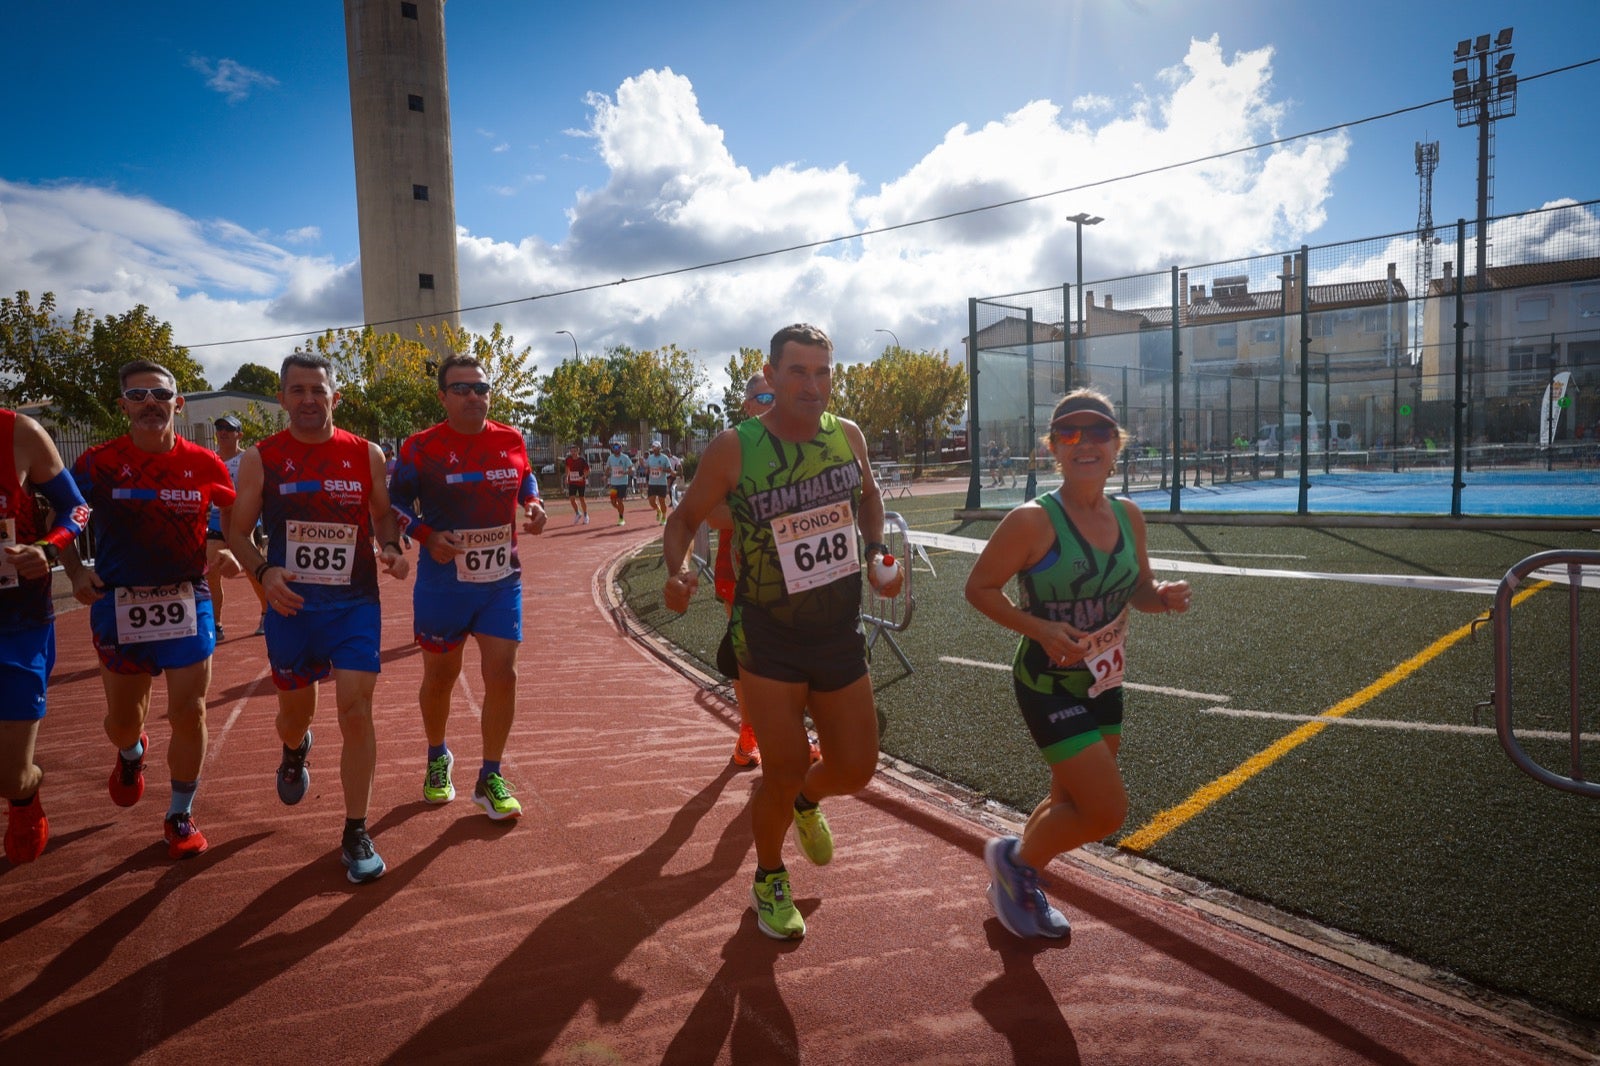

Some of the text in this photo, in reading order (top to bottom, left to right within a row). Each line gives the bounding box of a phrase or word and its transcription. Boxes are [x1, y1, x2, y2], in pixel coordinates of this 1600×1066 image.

[485, 468, 519, 481] SEUR
[324, 479, 363, 492] SEUR
[160, 488, 202, 502] SEUR
[747, 485, 797, 521] TEAM
[792, 511, 840, 533] FONDO
[301, 528, 346, 539] FONDO
[468, 531, 505, 544] FONDO
[295, 545, 347, 571] 685
[465, 546, 506, 571] 676
[794, 532, 848, 572] 648
[132, 587, 179, 599] FONDO
[128, 602, 185, 629] 939
